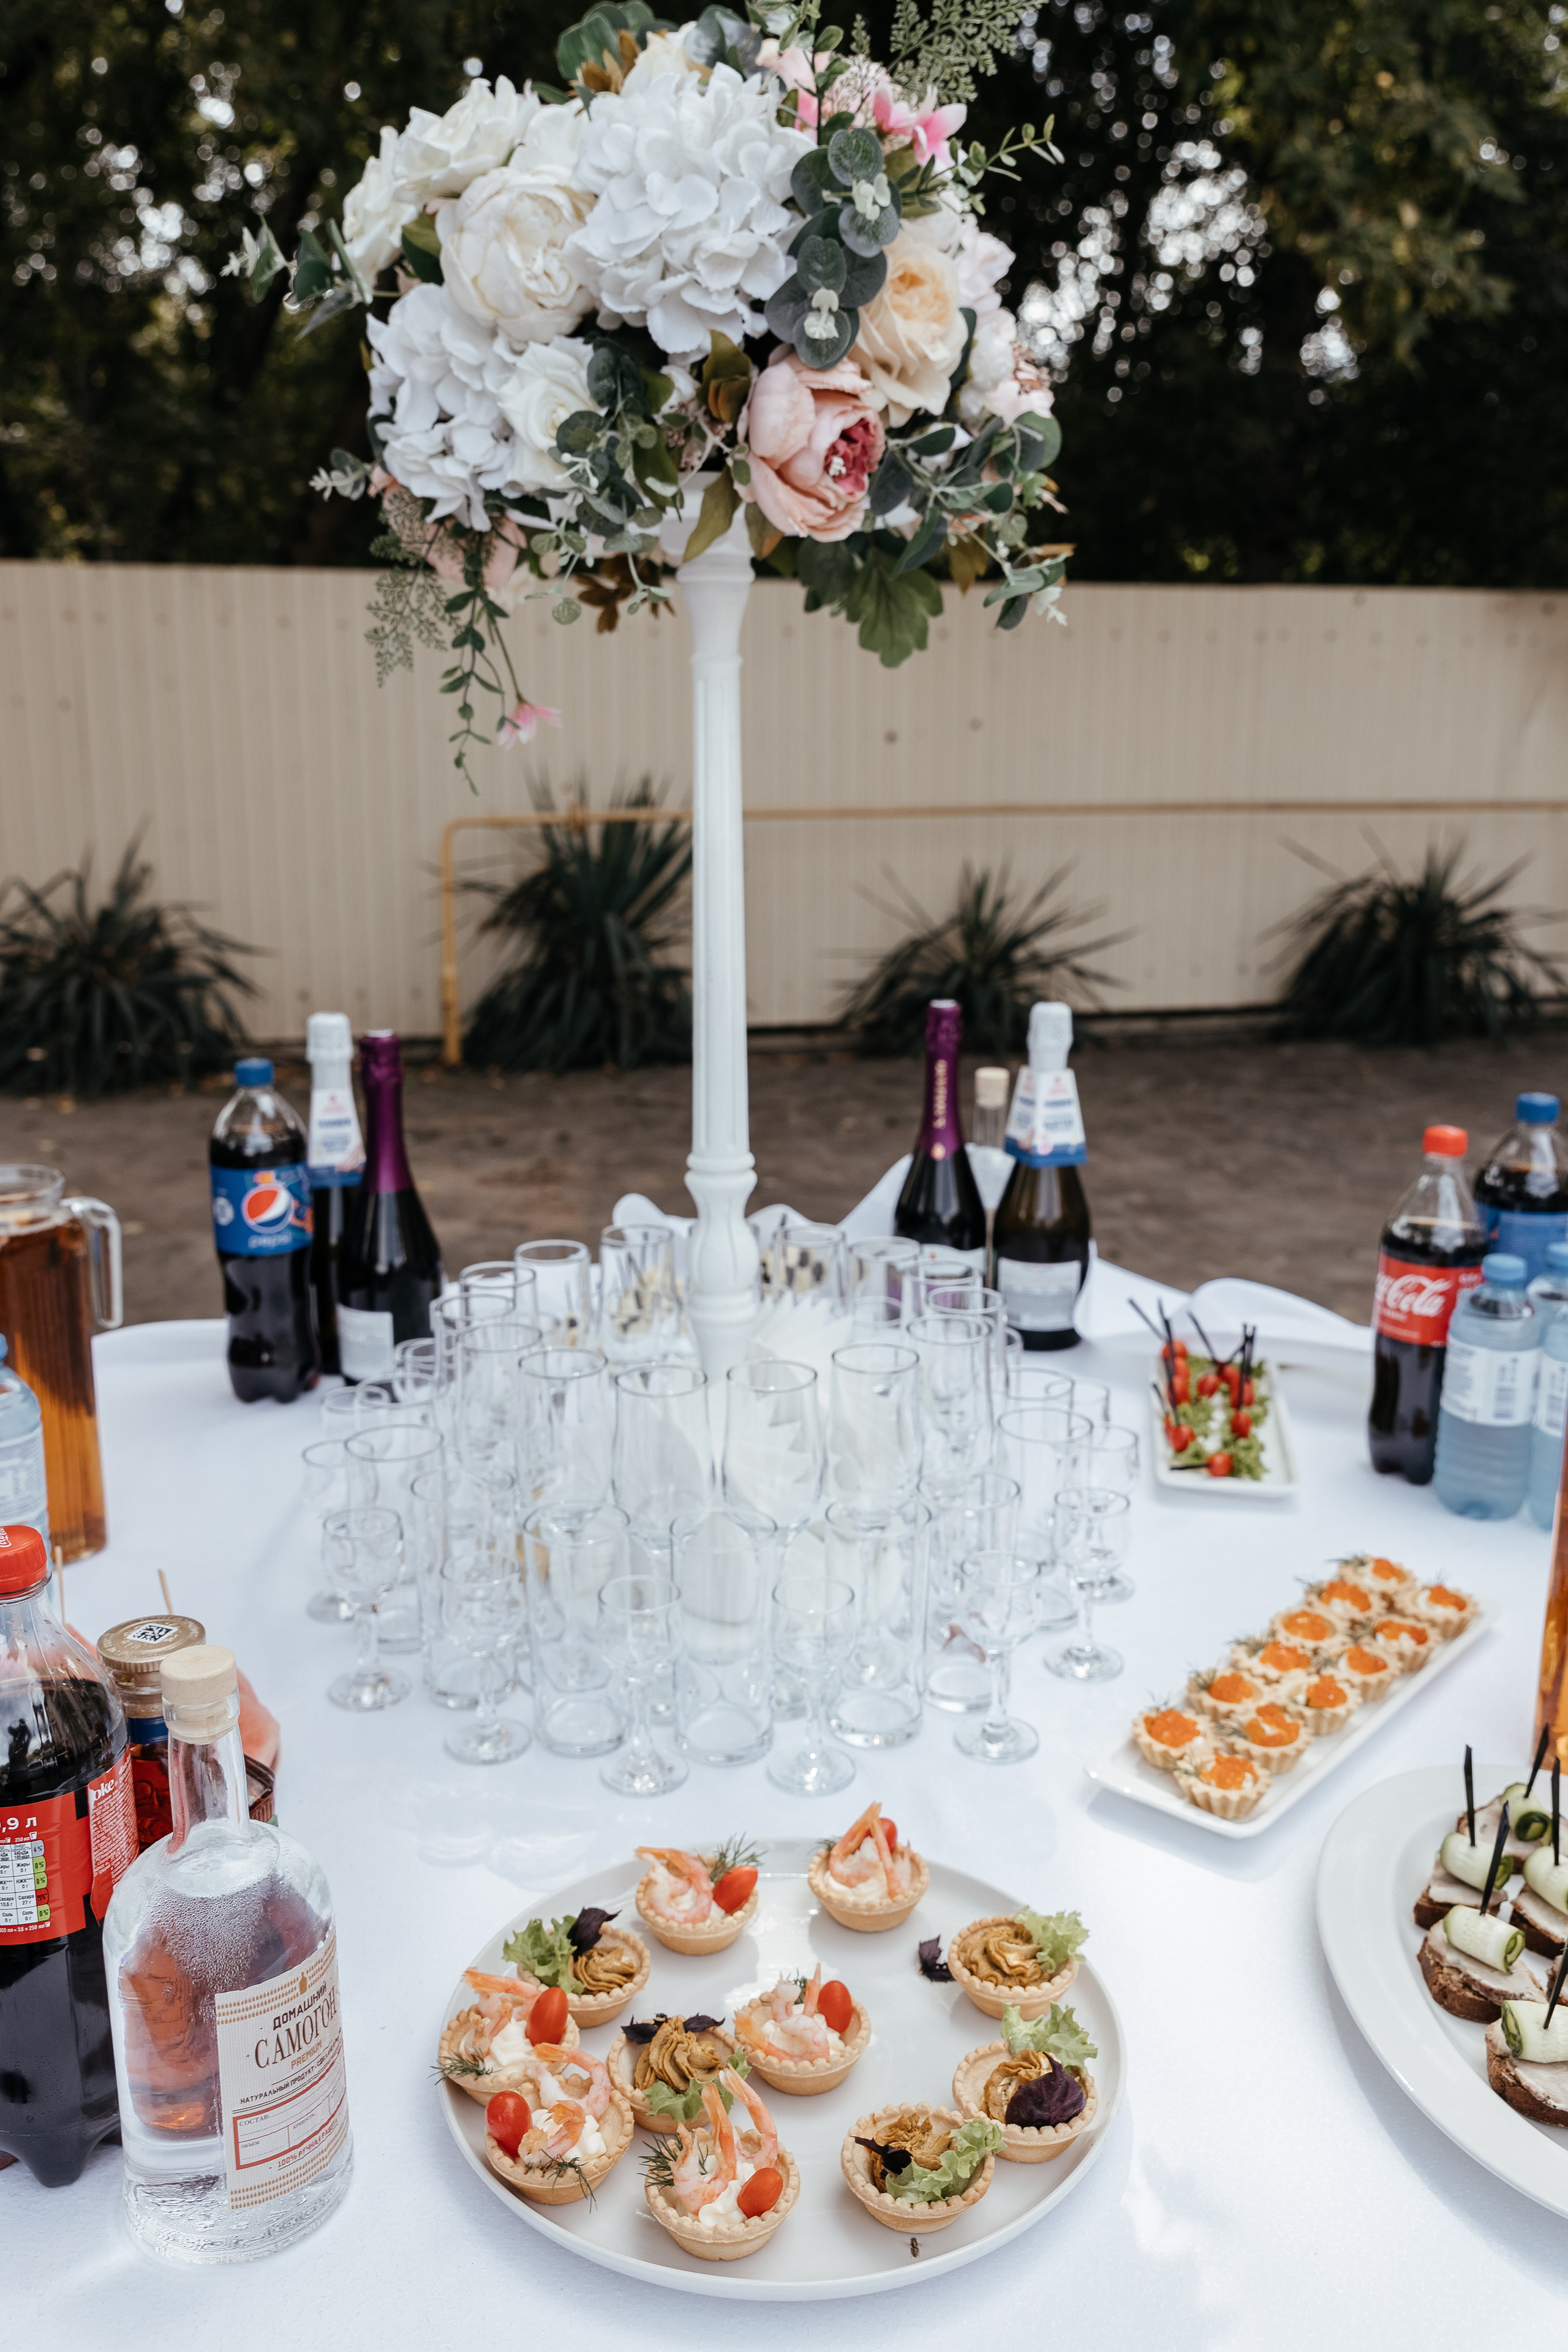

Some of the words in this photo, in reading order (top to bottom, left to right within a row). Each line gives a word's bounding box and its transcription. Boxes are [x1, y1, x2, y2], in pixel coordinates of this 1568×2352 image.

[94, 1779, 115, 1801] oke
[0, 1817, 19, 1833] ,9
[25, 1817, 37, 1828] л
[273, 1980, 327, 2030] ДОМАШНИЙ
[254, 1985, 337, 2068] САМОГОН
[291, 2040, 322, 2070] PREMIUM
[241, 2079, 290, 2104] НАТУРАЛЬНЫЙ
[290, 2066, 315, 2086] ПРОДУКТ
[277, 2155, 297, 2168] 100%
